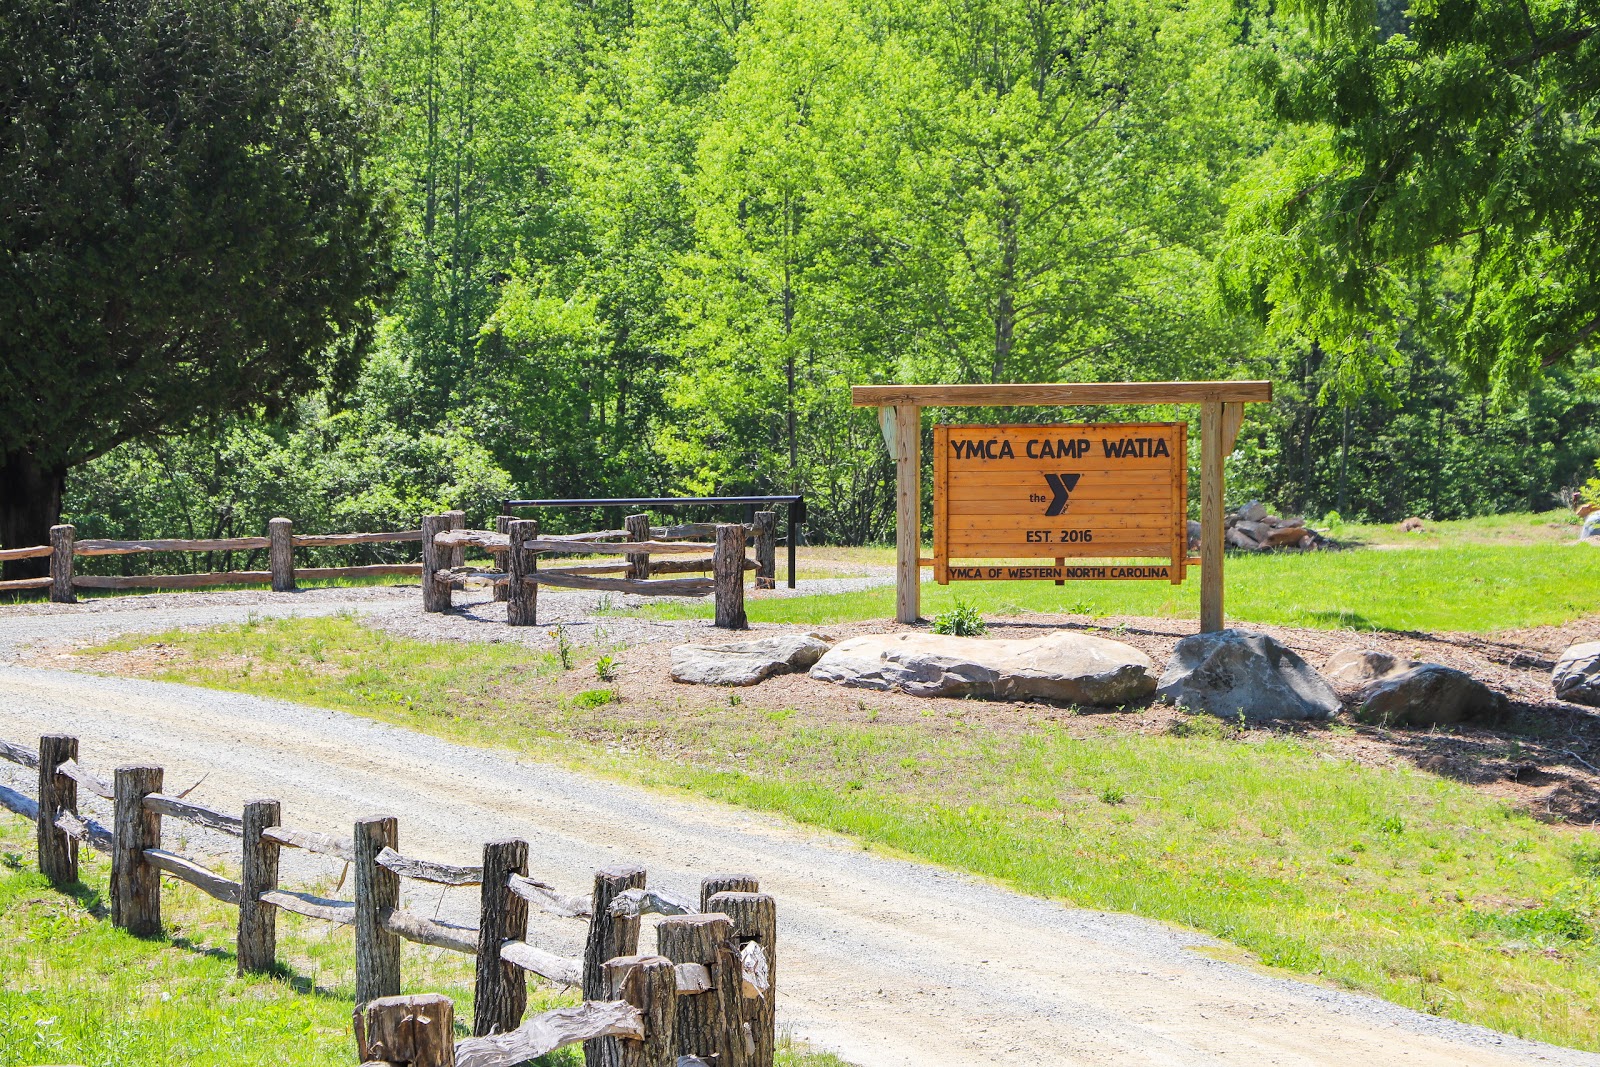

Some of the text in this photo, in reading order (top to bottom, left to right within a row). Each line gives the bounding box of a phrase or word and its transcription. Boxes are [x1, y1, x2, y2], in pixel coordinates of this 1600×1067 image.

[950, 437, 1170, 460] YMCA CAMP WATIA
[1029, 493, 1046, 503] the
[1026, 530, 1093, 543] EST. 2016
[950, 567, 1169, 579] YMCA OF WESTERN NORTH CAROLINA
